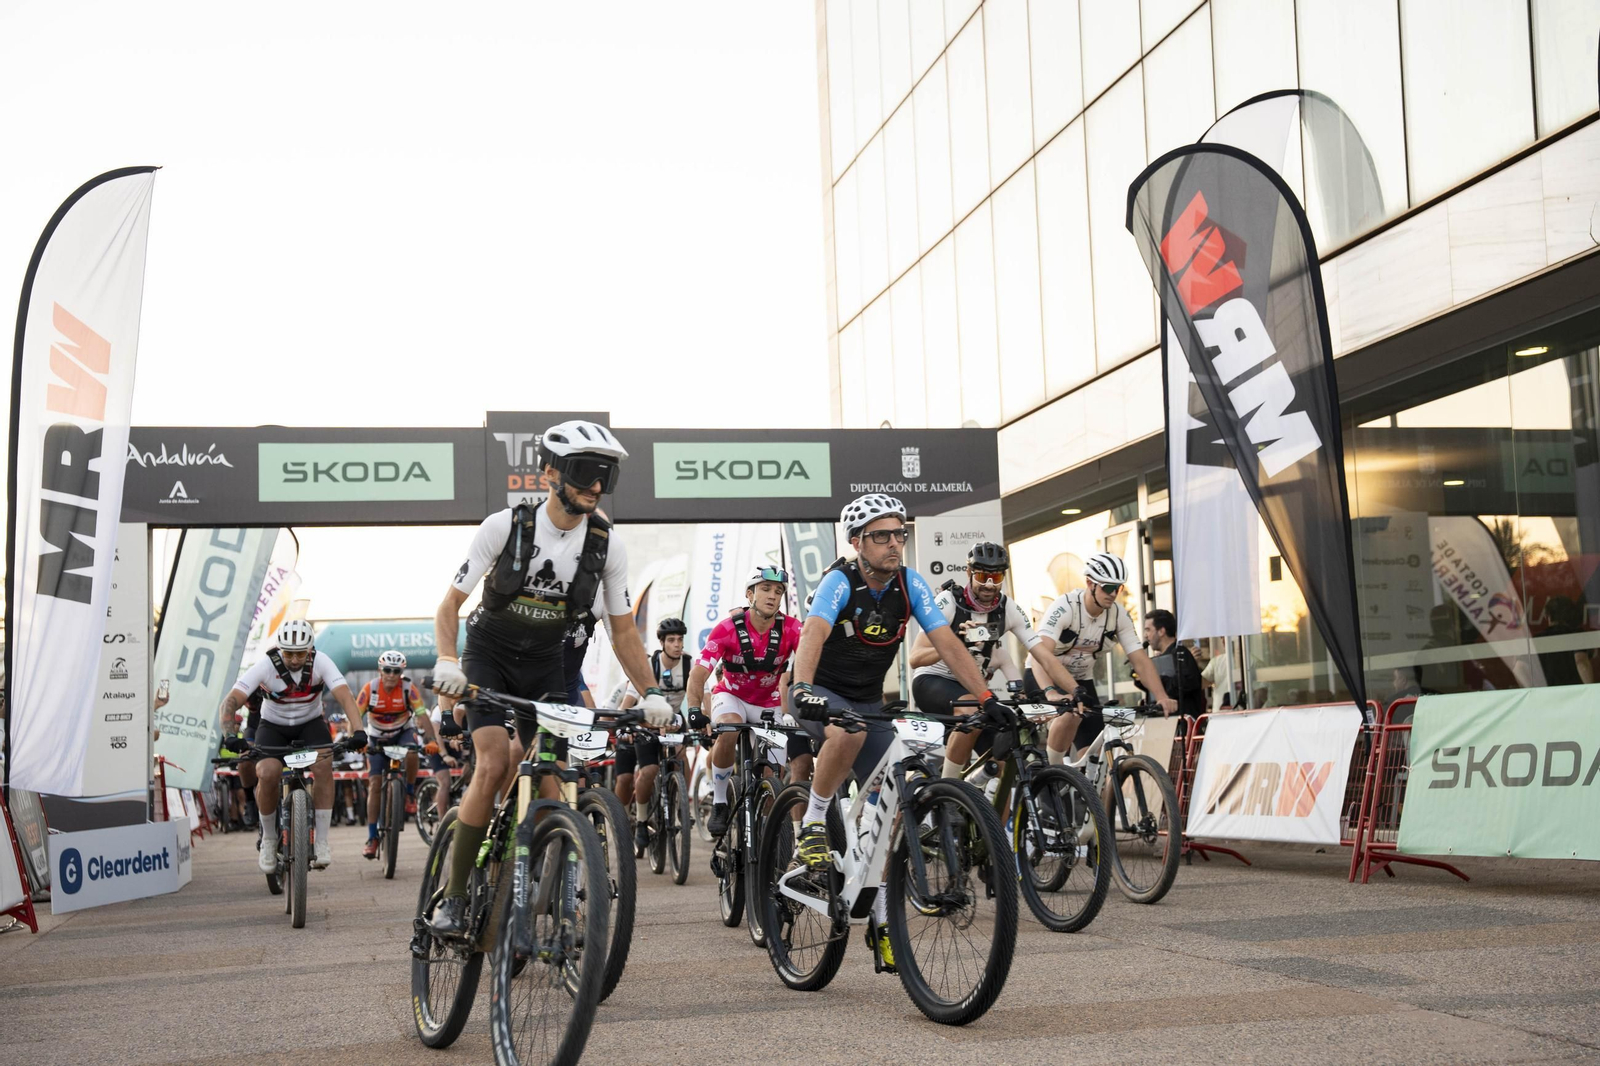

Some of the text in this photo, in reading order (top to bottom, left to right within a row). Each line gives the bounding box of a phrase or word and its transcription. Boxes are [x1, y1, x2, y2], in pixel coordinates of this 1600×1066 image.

[1160, 190, 1323, 479] MRW
[36, 300, 112, 605] MRW
[126, 442, 235, 468] Andalucía
[507, 474, 550, 490] DES
[850, 481, 973, 493] DIPUTACIÓN DE ALMERÍA
[949, 531, 986, 540] ALMERÍA
[706, 532, 726, 622] Cleardent
[175, 528, 247, 688] SKOD
[506, 602, 568, 620] NIVERSA
[351, 632, 438, 649] UNIVERS
[102, 691, 136, 700] Atalaya
[910, 719, 929, 733] 99
[1205, 761, 1336, 818] MRW
[87, 846, 170, 881] Cleardent
